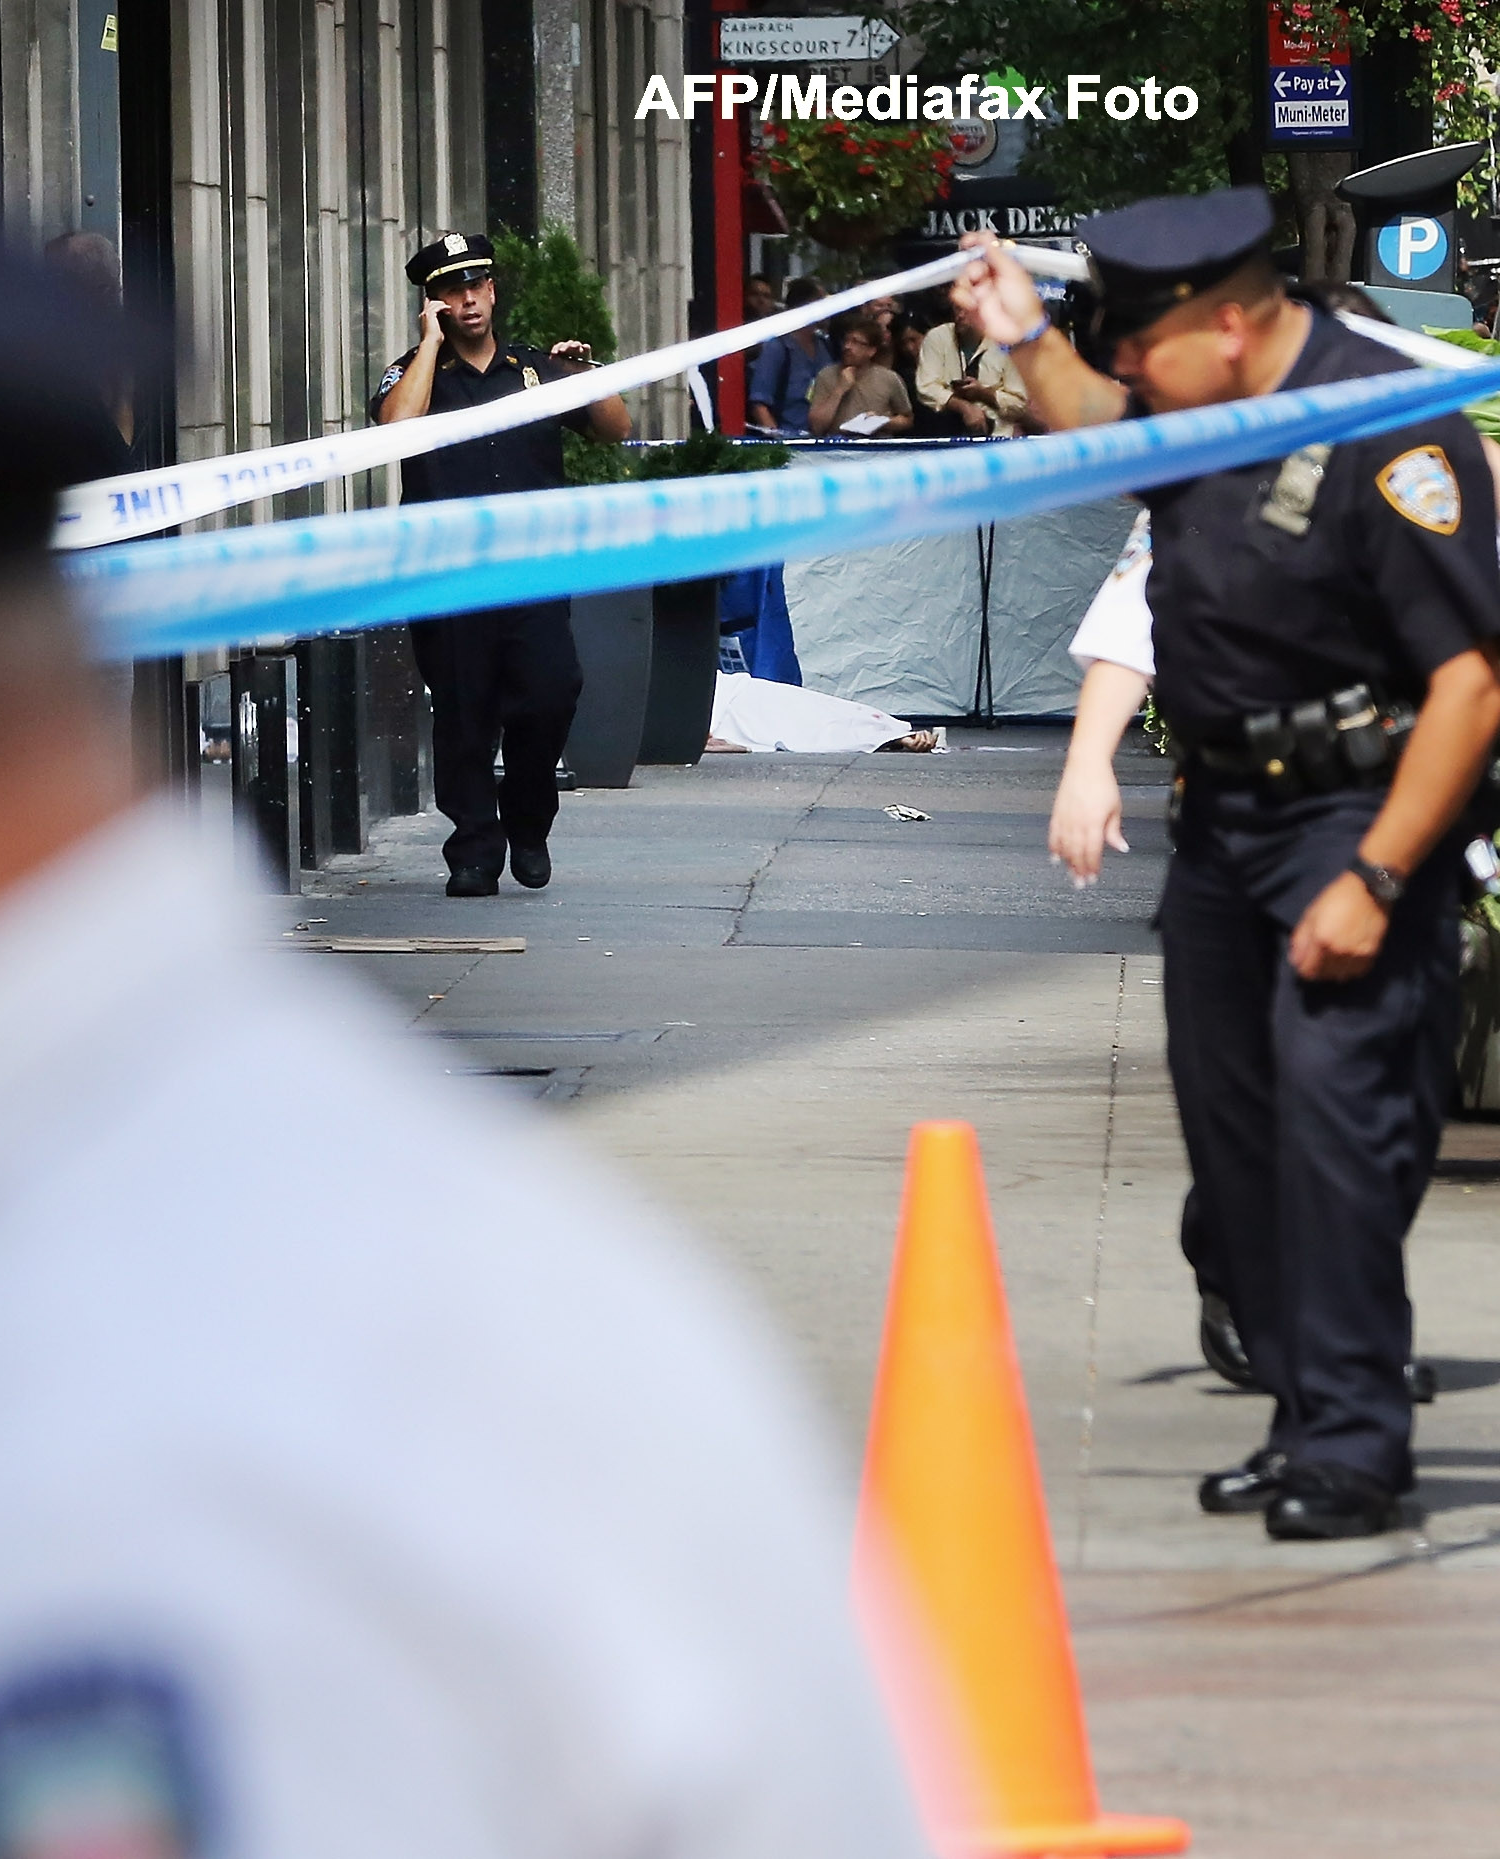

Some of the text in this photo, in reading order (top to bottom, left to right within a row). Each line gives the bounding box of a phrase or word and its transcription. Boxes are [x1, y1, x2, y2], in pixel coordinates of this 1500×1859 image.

[722, 40, 842, 55] KINGSCOURT
[1293, 76, 1330, 94] Pay at
[1278, 105, 1347, 122] Muni-Meter
[922, 207, 1000, 237] JACK
[1398, 216, 1439, 275] P
[108, 482, 186, 526] LINE
